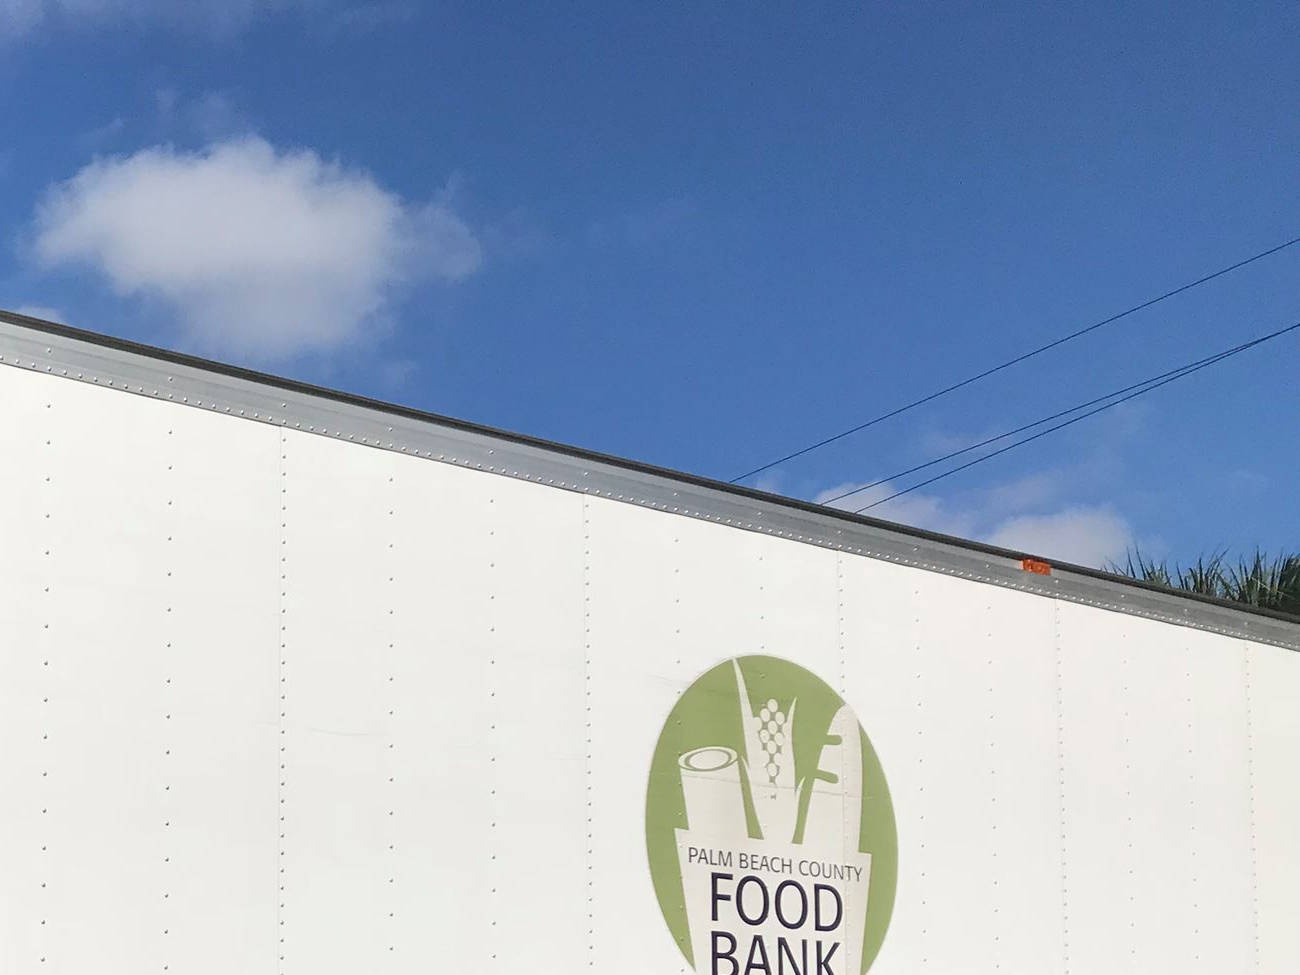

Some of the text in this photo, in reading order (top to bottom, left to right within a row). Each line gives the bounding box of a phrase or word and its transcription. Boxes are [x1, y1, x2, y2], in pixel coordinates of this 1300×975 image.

[688, 847, 862, 882] PALM BEACH COUNTY
[711, 872, 843, 932] FOOD
